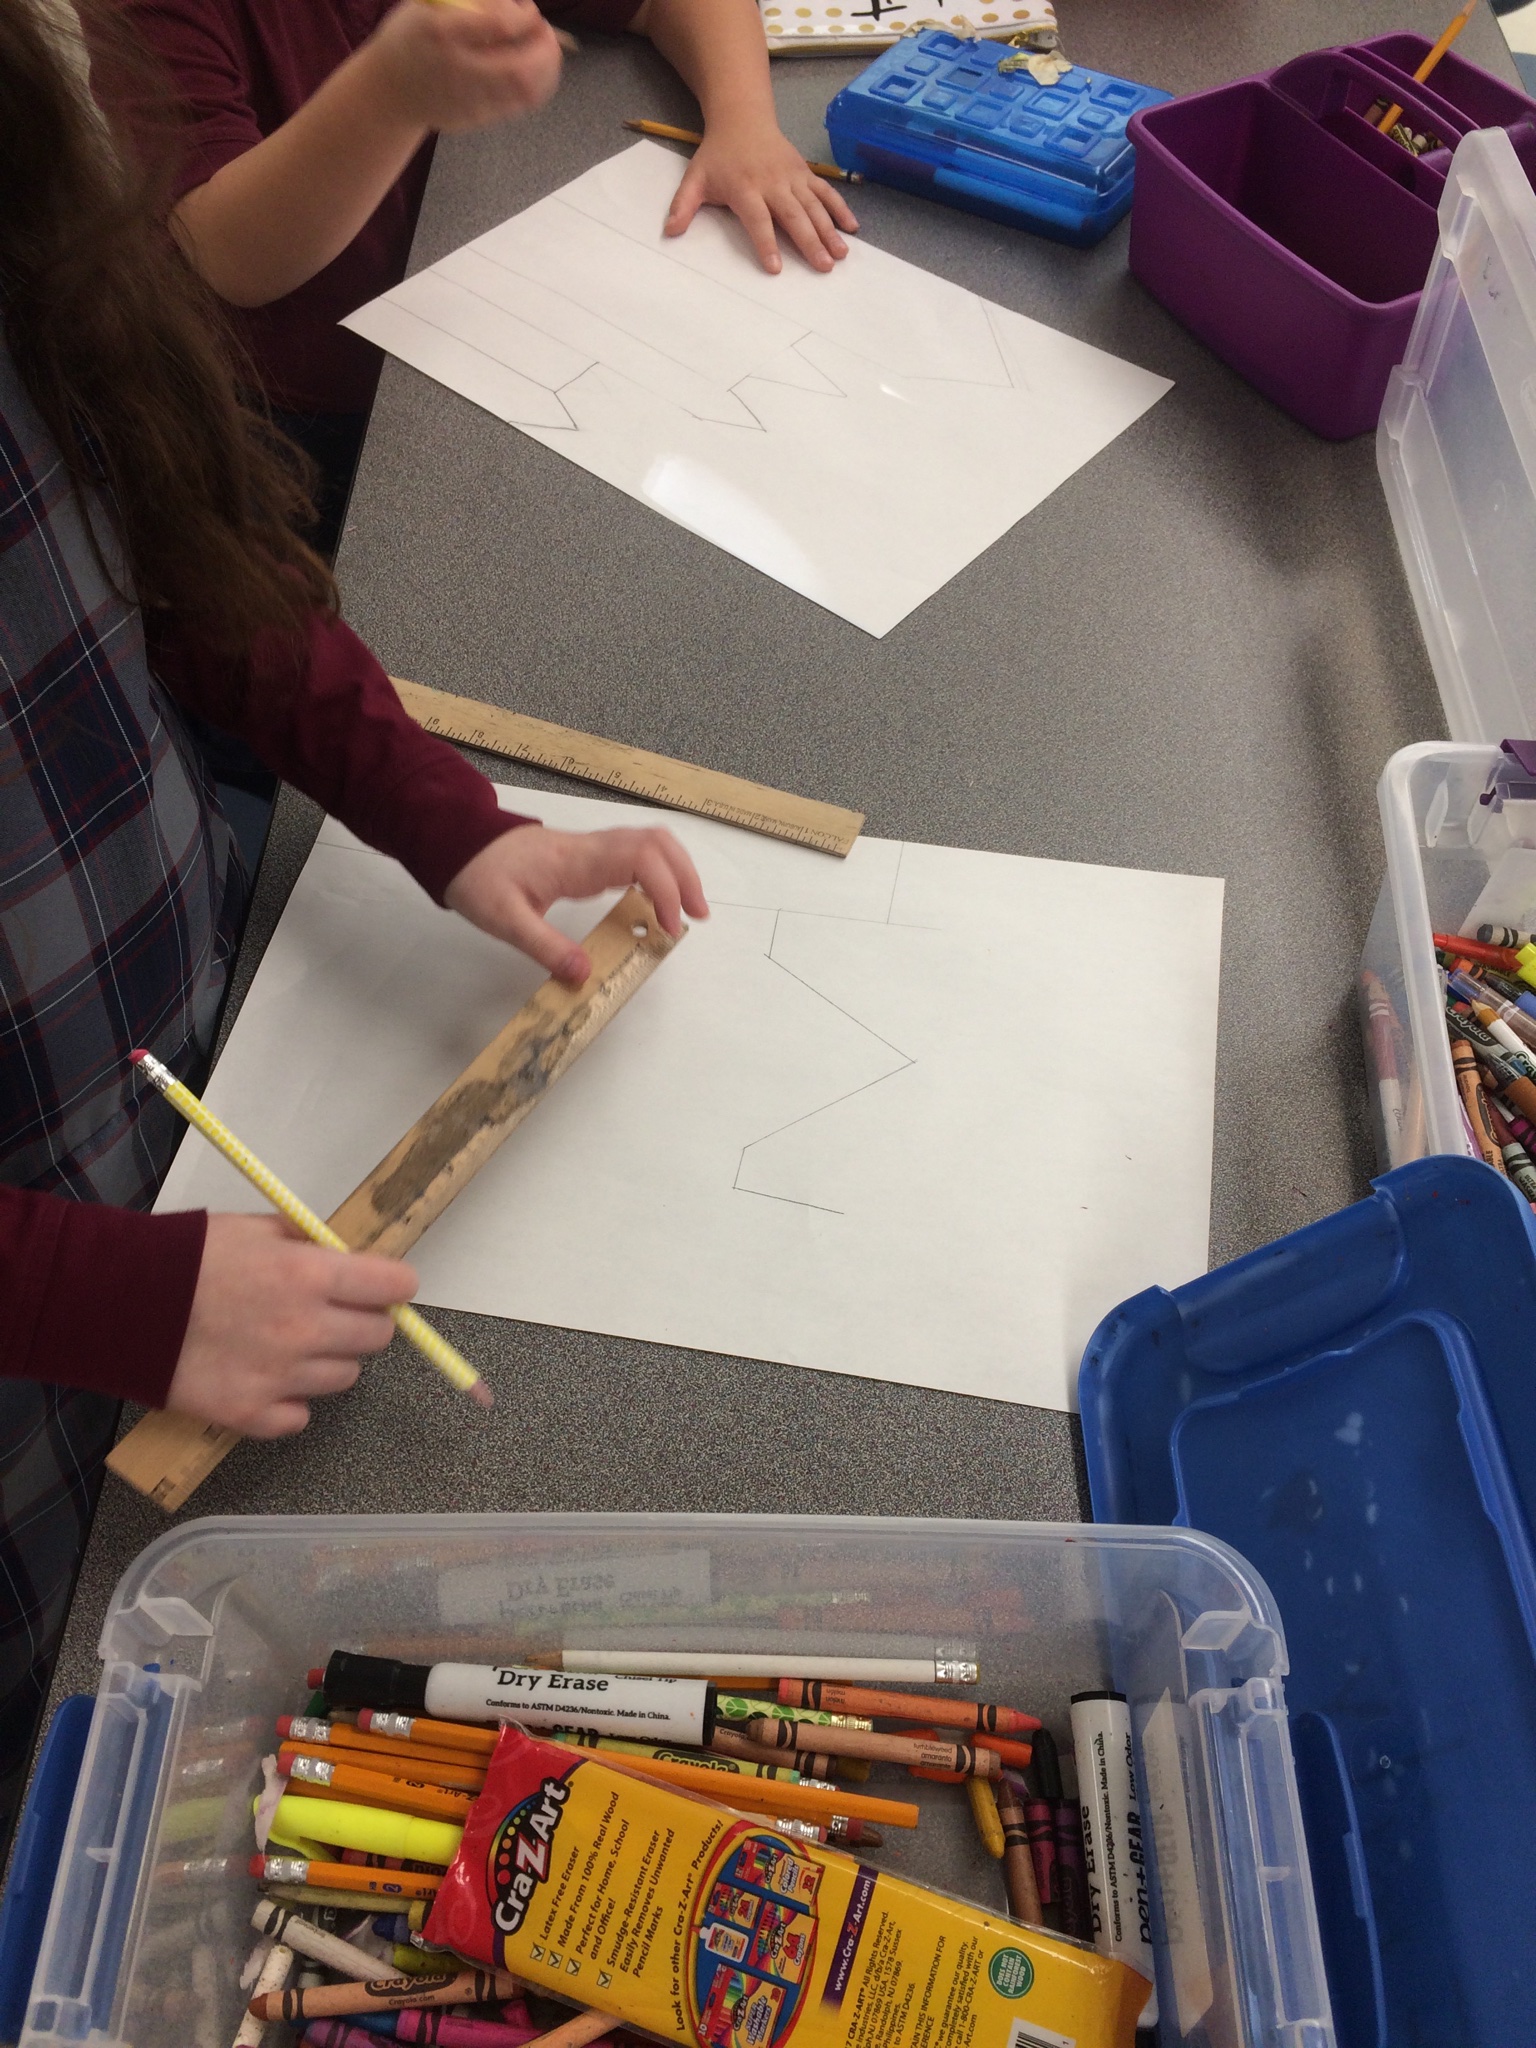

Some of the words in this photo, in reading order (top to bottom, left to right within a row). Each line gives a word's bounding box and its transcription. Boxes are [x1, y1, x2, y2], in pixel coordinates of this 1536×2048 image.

[497, 1670, 542, 1691] Dry
[547, 1674, 609, 1691] Erase
[485, 1698, 520, 1708] Conforms
[530, 1703, 553, 1711] ASTM
[647, 1712, 670, 1720] China.
[1098, 1757, 1106, 1766] in
[1122, 1731, 1134, 1766] Odor
[1098, 1767, 1108, 1789] Made
[1125, 1767, 1137, 1801] Low
[609, 1818, 630, 1857] School
[690, 1819, 724, 1871] Products!
[556, 1913, 576, 1948] Made
[568, 1883, 586, 1913] From
[580, 1849, 599, 1882] 100%
[591, 1823, 608, 1850] Real
[600, 1790, 620, 1823] Wood
[595, 1857, 616, 1894] Home,
[777, 1856, 797, 1893] Colored
[1107, 1861, 1118, 1887] ASTM
[538, 1907, 558, 1940] Latex
[551, 1881, 567, 1907] Free
[560, 1845, 581, 1881] Eraser
[589, 1894, 603, 1912] for
[605, 1864, 649, 1968] Smudge-Resistant
[641, 1829, 660, 1865] Eraser
[618, 1937, 639, 1973] Easily
[630, 1886, 655, 1937] Removes
[648, 1828, 675, 1886] Unwanted
[1110, 1889, 1118, 1898] to
[574, 1912, 596, 1954] Perfect
[586, 1934, 603, 1960] and
[596, 1897, 616, 1935] Office!
[829, 1878, 872, 1991] www.Cra-Z-Art.com
[872, 1909, 889, 1948] Reserved.
[1110, 1899, 1123, 1941] Conforms
[631, 1941, 651, 1977] Pencil
[643, 1904, 663, 1942] Marks
[936, 1934, 946, 1952] FOR
[977, 1948, 984, 1959] or
[670, 1939, 681, 1974] other
[865, 1948, 879, 1975] Rights
[872, 1959, 885, 1982] d/b/a
[955, 1971, 969, 2004] satisfied
[964, 1951, 974, 1969] with
[969, 1935, 978, 1950] our
[995, 1967, 1005, 1985] DOES
[1000, 1953, 1009, 1968] NOT
[1002, 1956, 1015, 1987] CONTAIN
[670, 1978, 680, 1996] for
[861, 1975, 870, 1987] All
[870, 1997, 883, 2023] 07869
[883, 1956, 894, 1976] 1578
[889, 1928, 902, 1955] Sussex
[920, 1953, 941, 2011] INFORMATION
[951, 1971, 960, 1985] our
[1007, 1954, 1022, 1993] RAINFOREST
[1015, 1965, 1026, 1987] WOOD
[887, 1987, 895, 1998] NJ
[902, 1981, 916, 2010] D4236.
[940, 1986, 957, 2028] guarantee
[958, 1959, 982, 2028] 1-800-CRA-Z-ART
[671, 2000, 685, 2031] Look
[895, 2010, 908, 2035] ASTM
[915, 2011, 926, 2030] THIS
[893, 2035, 901, 2045] to
[936, 2028, 945, 2041] we
[953, 2029, 964, 2045] call
